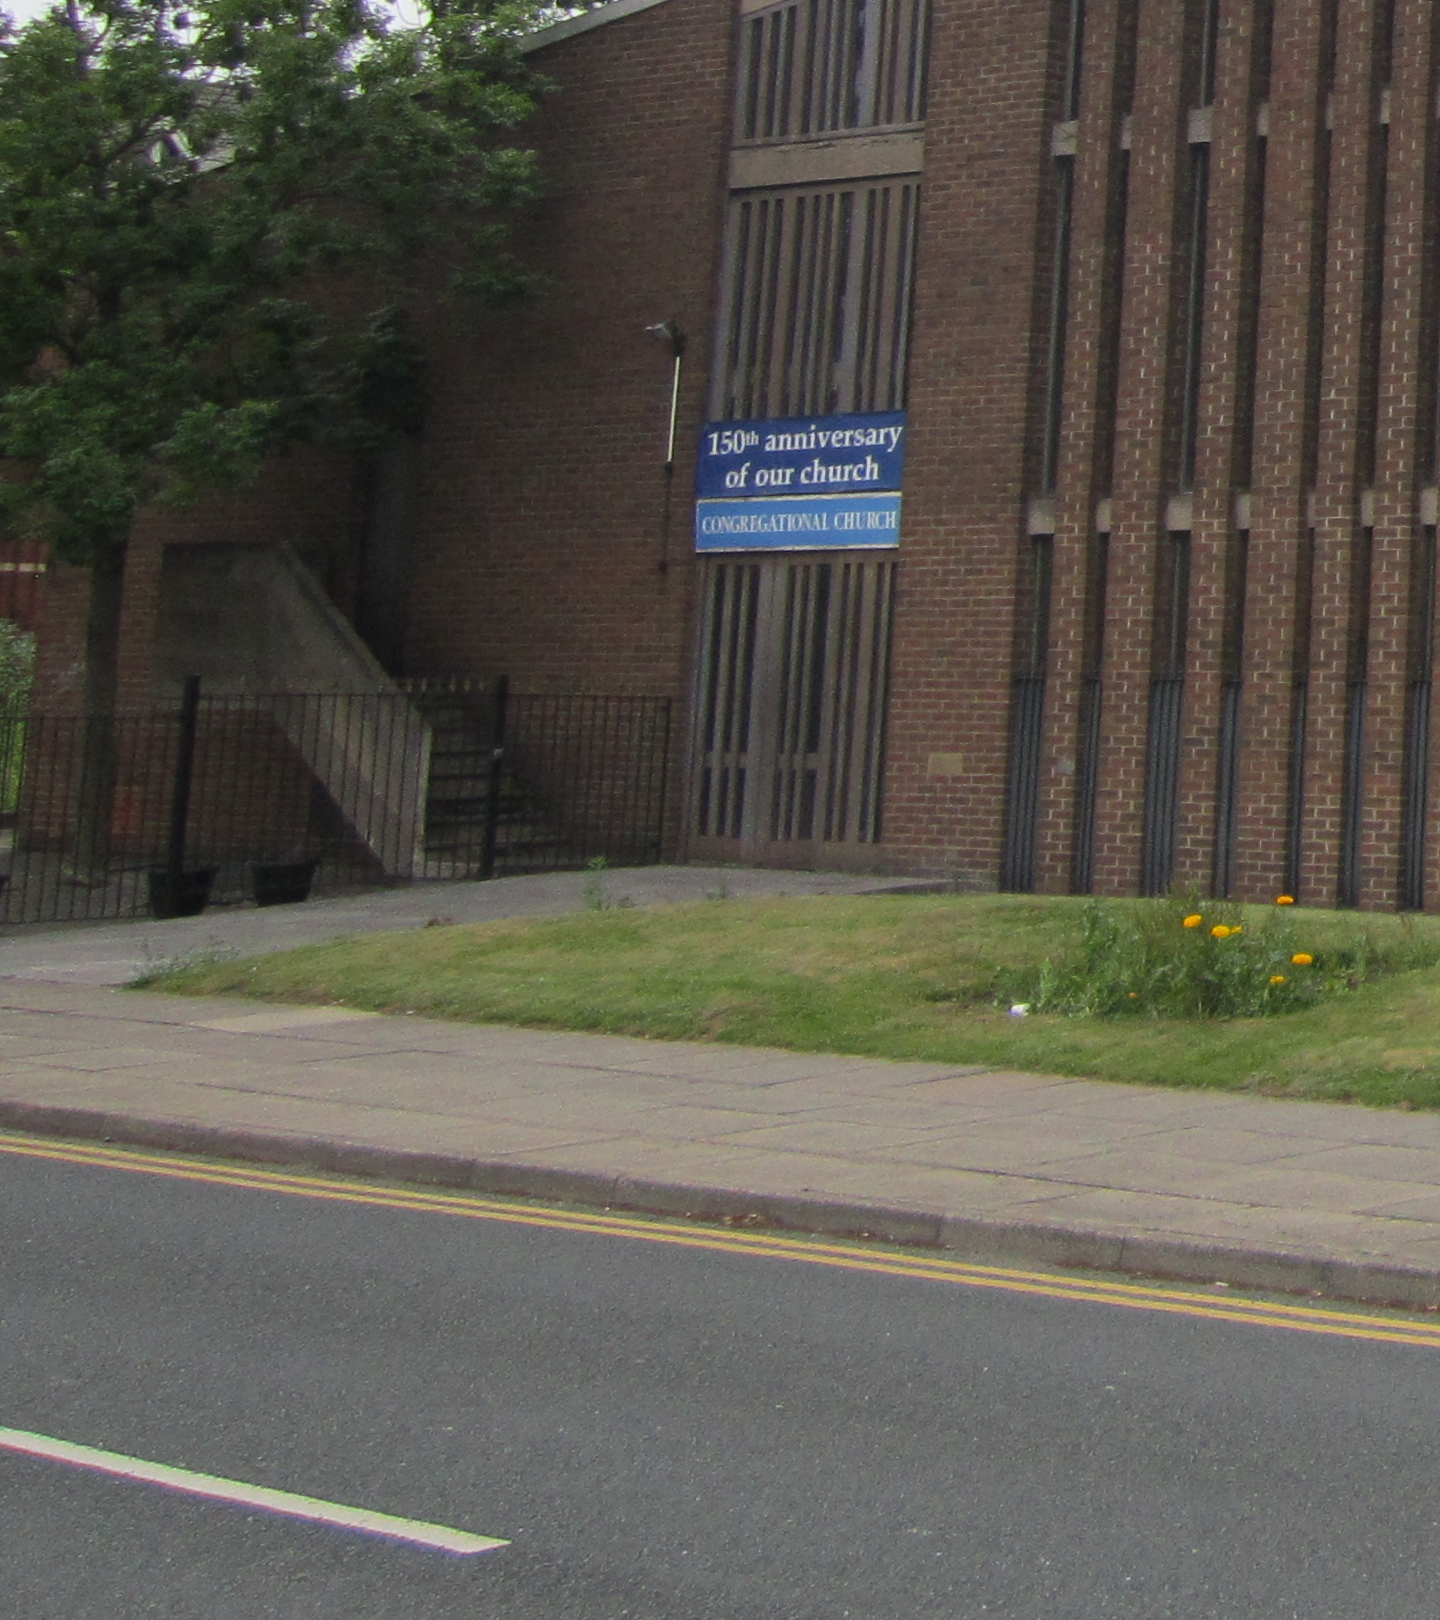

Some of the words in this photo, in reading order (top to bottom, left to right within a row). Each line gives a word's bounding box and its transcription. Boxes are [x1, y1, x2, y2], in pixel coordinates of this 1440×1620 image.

[709, 430, 759, 456] 150th
[764, 424, 903, 452] anniversary
[725, 462, 750, 489] of
[755, 467, 794, 487] our
[800, 455, 879, 484] church
[702, 513, 829, 534] CONGREGATIONAL
[833, 511, 896, 530] CHURCH
